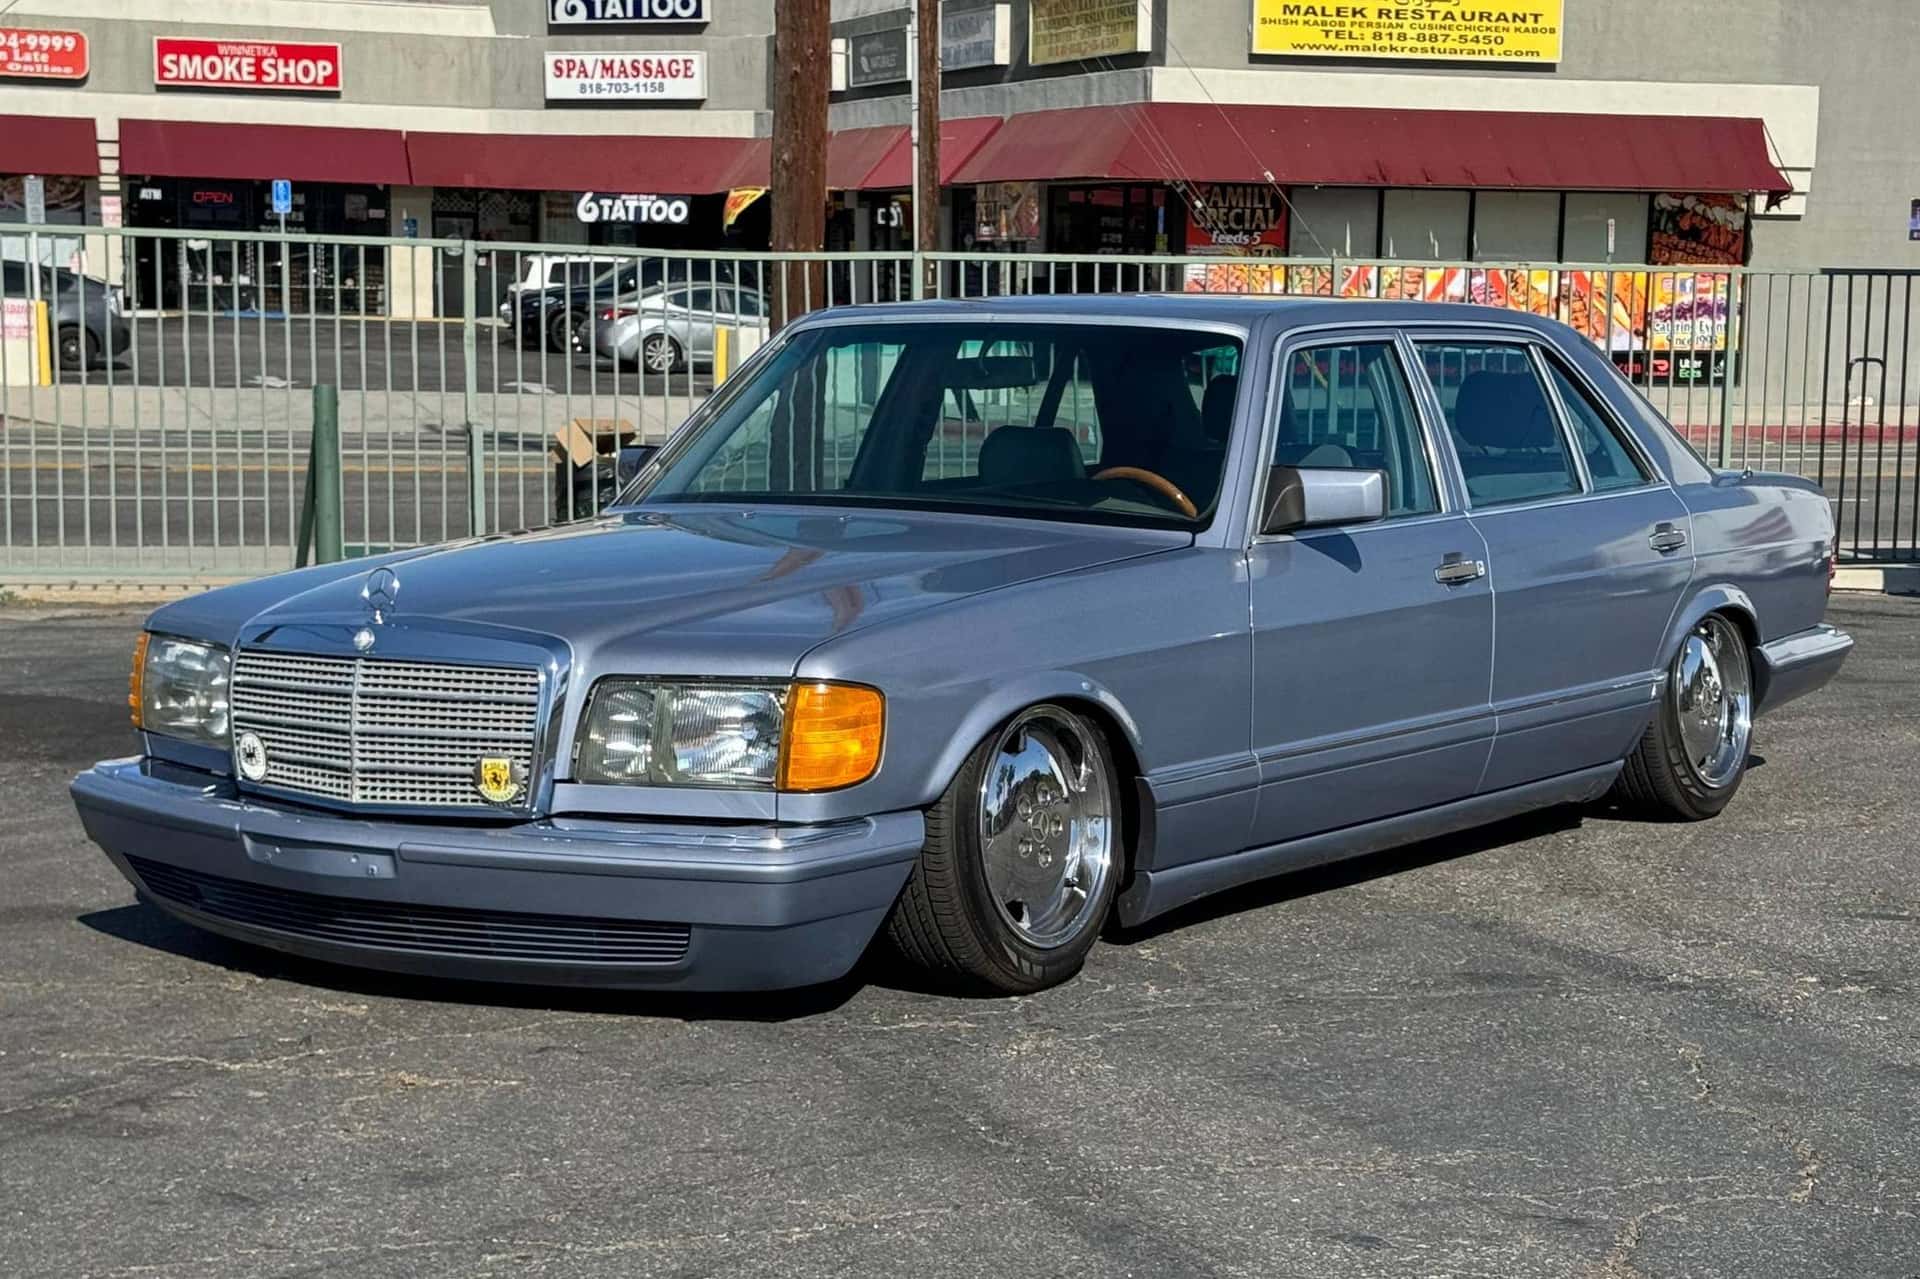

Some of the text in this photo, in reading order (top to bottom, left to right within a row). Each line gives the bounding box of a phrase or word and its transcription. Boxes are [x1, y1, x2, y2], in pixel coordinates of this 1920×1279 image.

[1282, 4, 1544, 24] MALEK RESTAURANT
[1260, 17, 1299, 26] SHISH
[1303, 19, 1346, 28] KABOB
[1350, 20, 1404, 30] PERSIAN
[1514, 26, 1556, 34] KABOB
[1321, 29, 1505, 45] TEL: 818-887-5450
[217, 44, 279, 58] WINNETKA
[162, 53, 334, 84] SMOKE SHOP
[553, 58, 695, 79] SPA/MASSAGE
[579, 82, 665, 94] 818-703-1158
[193, 191, 233, 204] OPEN
[600, 199, 688, 223] TATTOO
[1193, 208, 1279, 230] SPECIAL
